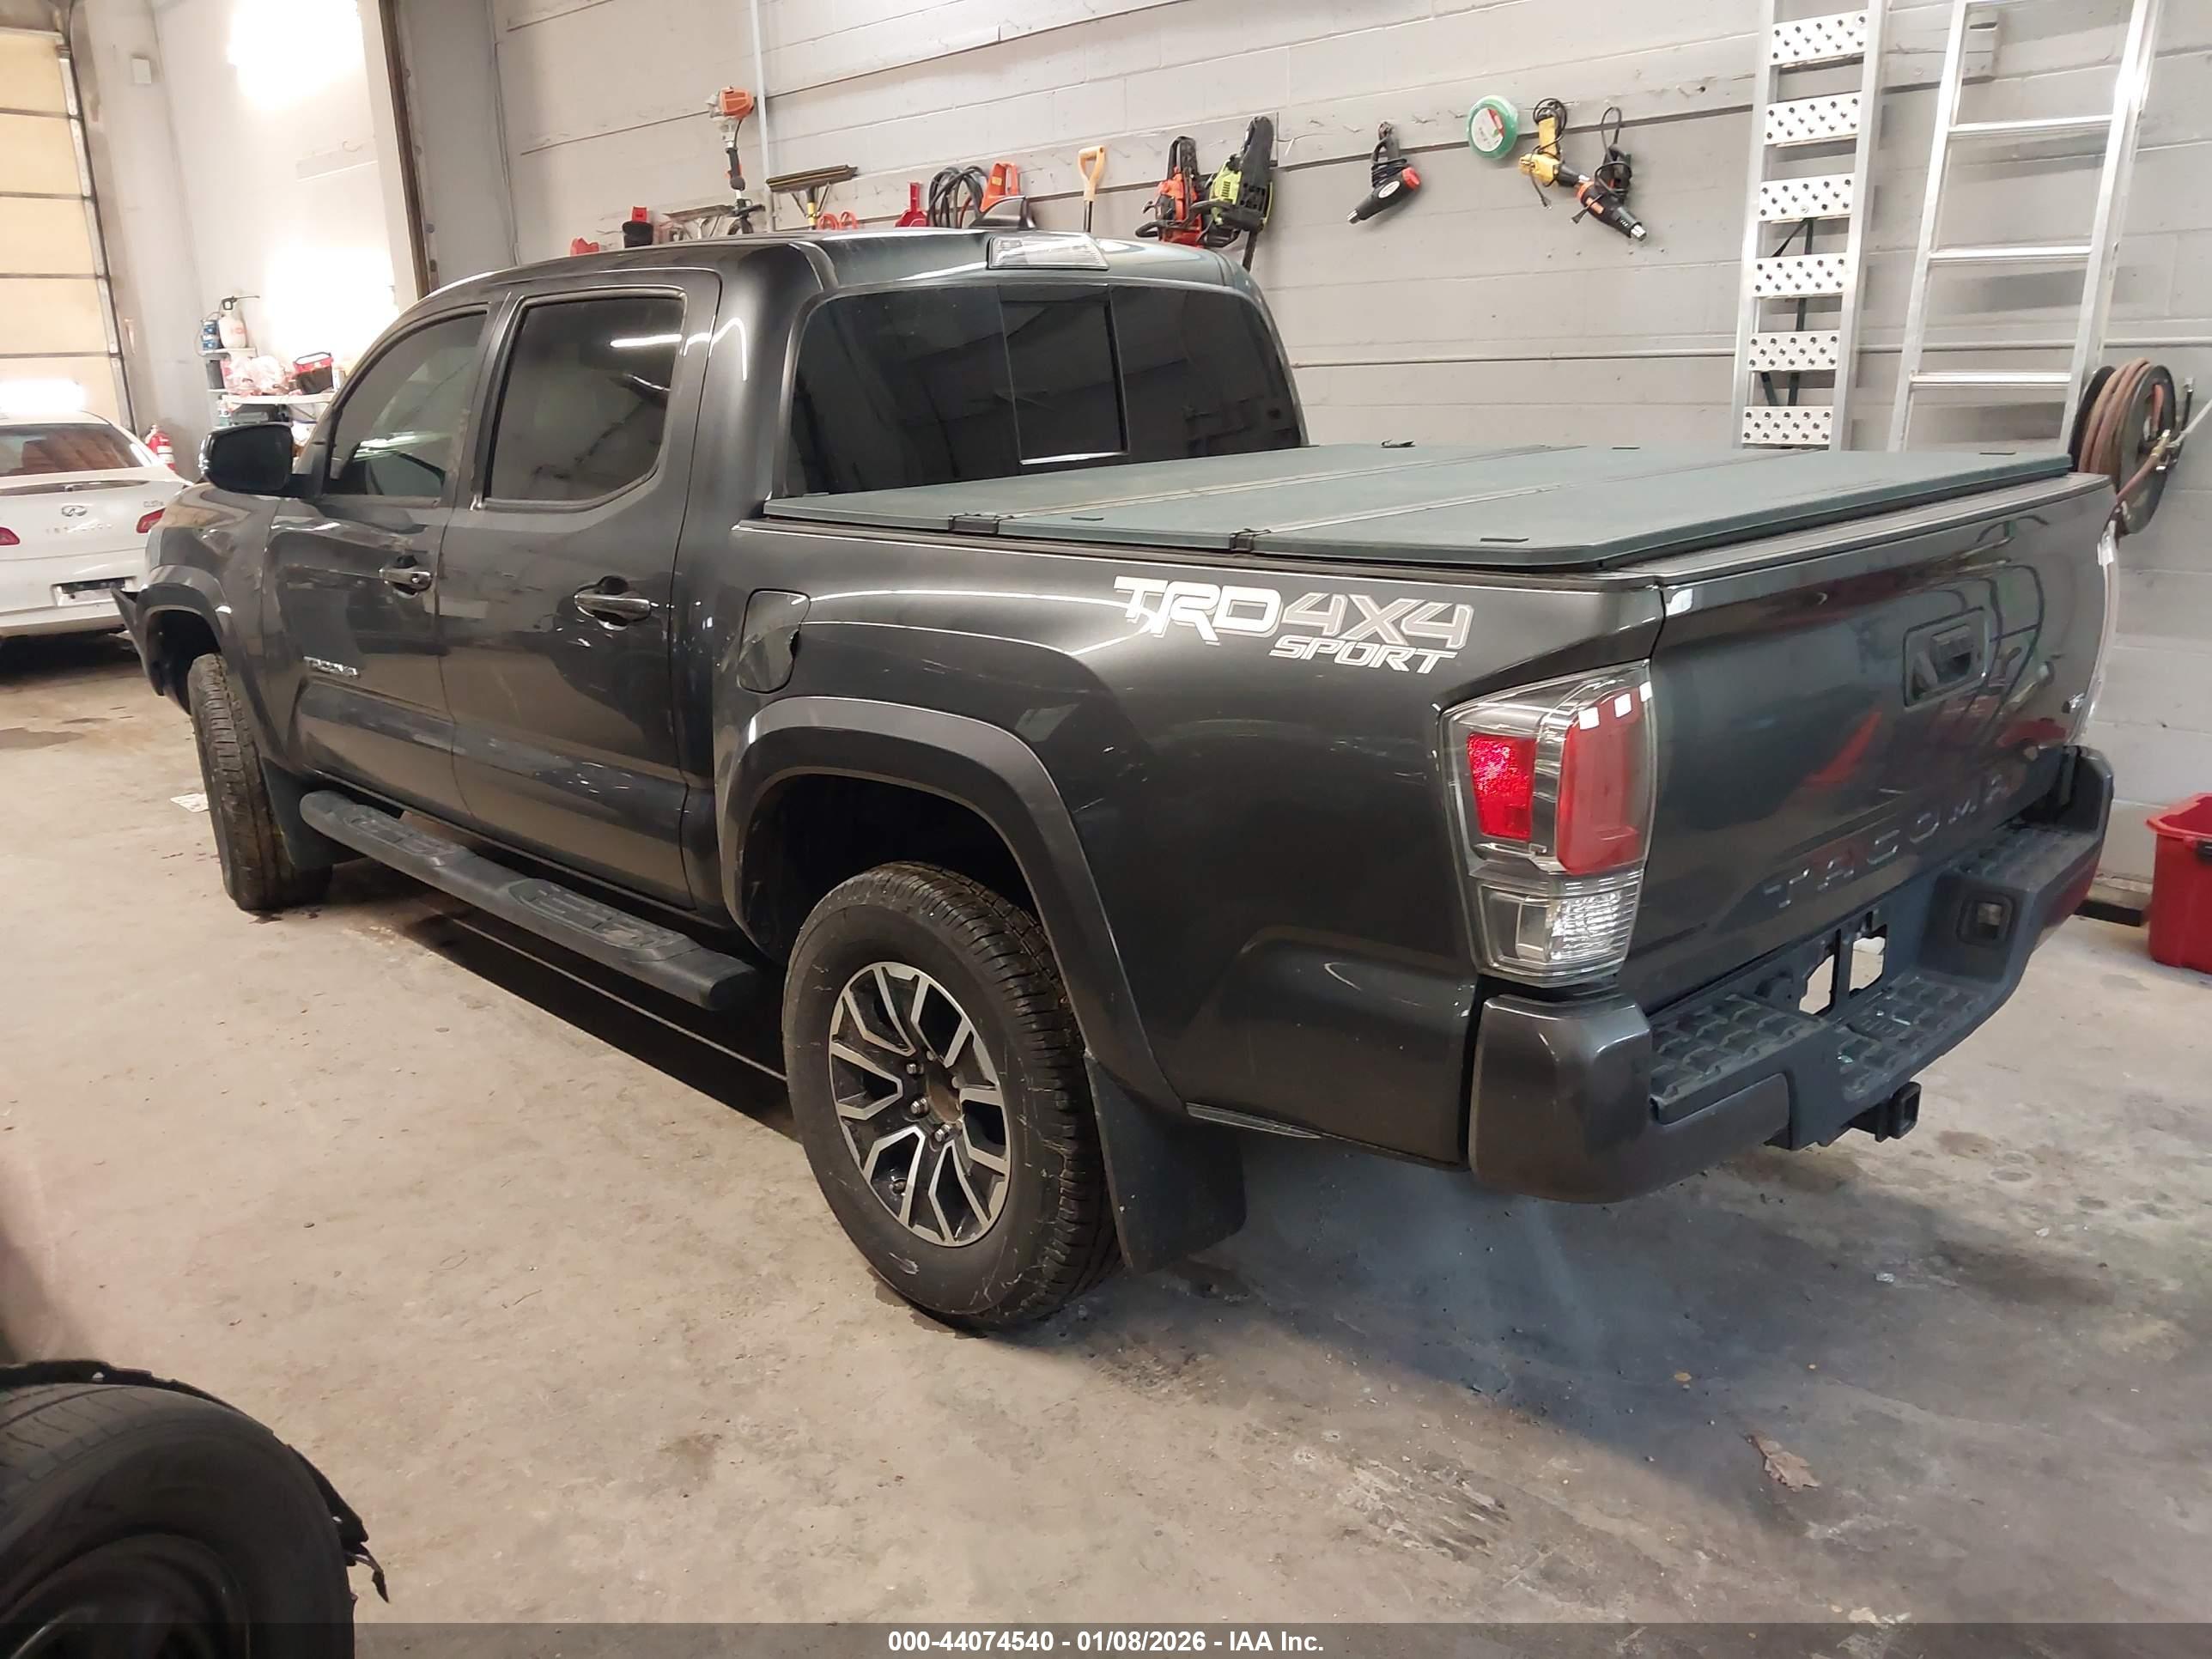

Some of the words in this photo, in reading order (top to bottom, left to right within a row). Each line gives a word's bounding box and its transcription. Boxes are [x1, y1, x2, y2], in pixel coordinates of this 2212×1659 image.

[1114, 575, 1283, 646] TRD
[1281, 592, 1474, 649] 4X4
[1269, 635, 1458, 674] SPORT
